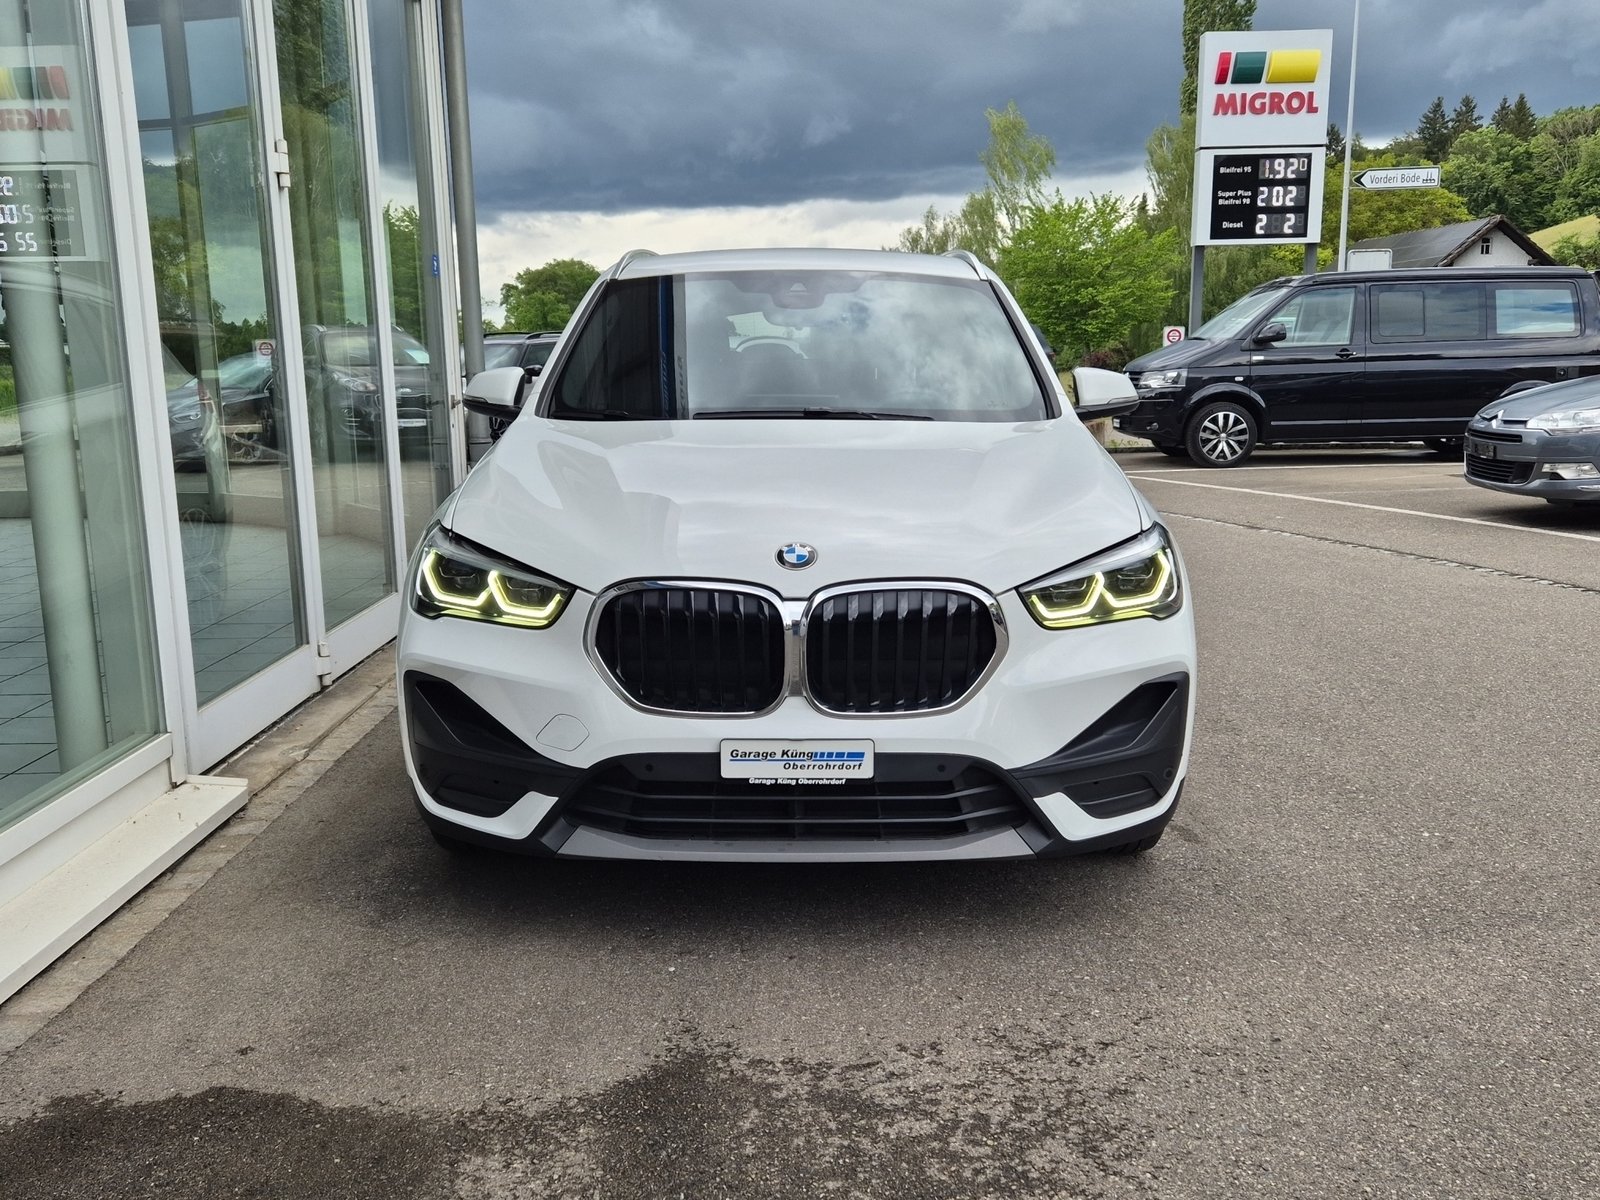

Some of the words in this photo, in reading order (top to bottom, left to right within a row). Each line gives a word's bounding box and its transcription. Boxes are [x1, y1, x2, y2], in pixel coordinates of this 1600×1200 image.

[1213, 91, 1319, 115] MIGROL
[1219, 166, 1243, 174] Bleifrei
[1369, 173, 1398, 185] Vorderi
[1217, 190, 1238, 198] Super
[1222, 221, 1244, 229] Diesel
[729, 749, 777, 761] Garage
[780, 748, 814, 761] Küng
[783, 762, 862, 770] Oberrohrdorf
[749, 777, 775, 785] Garage
[777, 777, 796, 785] Küng
[798, 777, 846, 785] Oberrohrdorf
